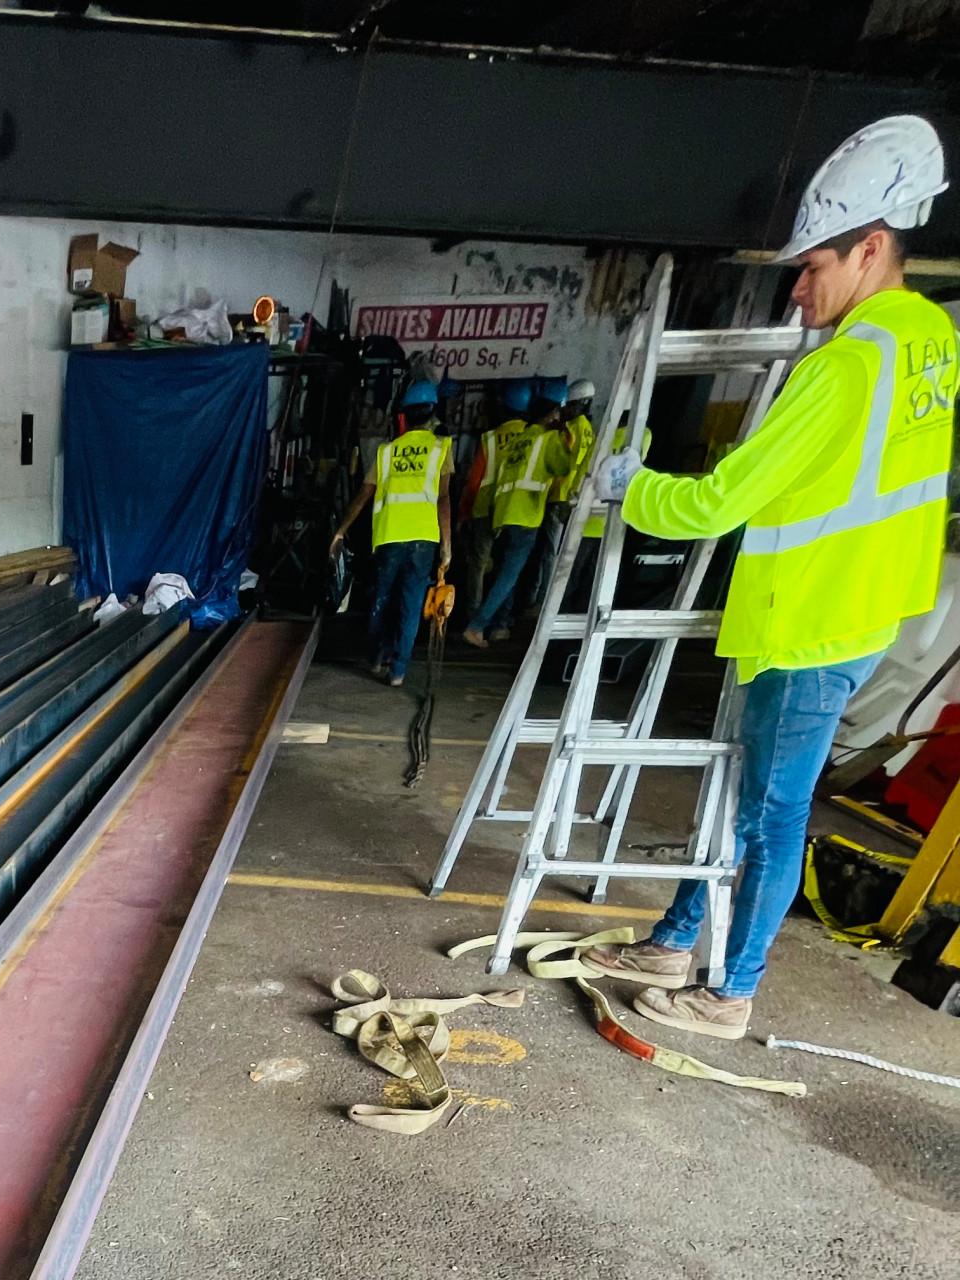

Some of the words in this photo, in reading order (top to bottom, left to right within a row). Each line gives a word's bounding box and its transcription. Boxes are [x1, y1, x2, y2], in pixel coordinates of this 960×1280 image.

[361, 308, 431, 339] SUITES
[437, 306, 545, 337] AVAILABLE
[476, 347, 501, 369] Sq.
[510, 346, 529, 366] Ft.
[392, 445, 427, 457] LEMA
[393, 461, 424, 472] SONS
